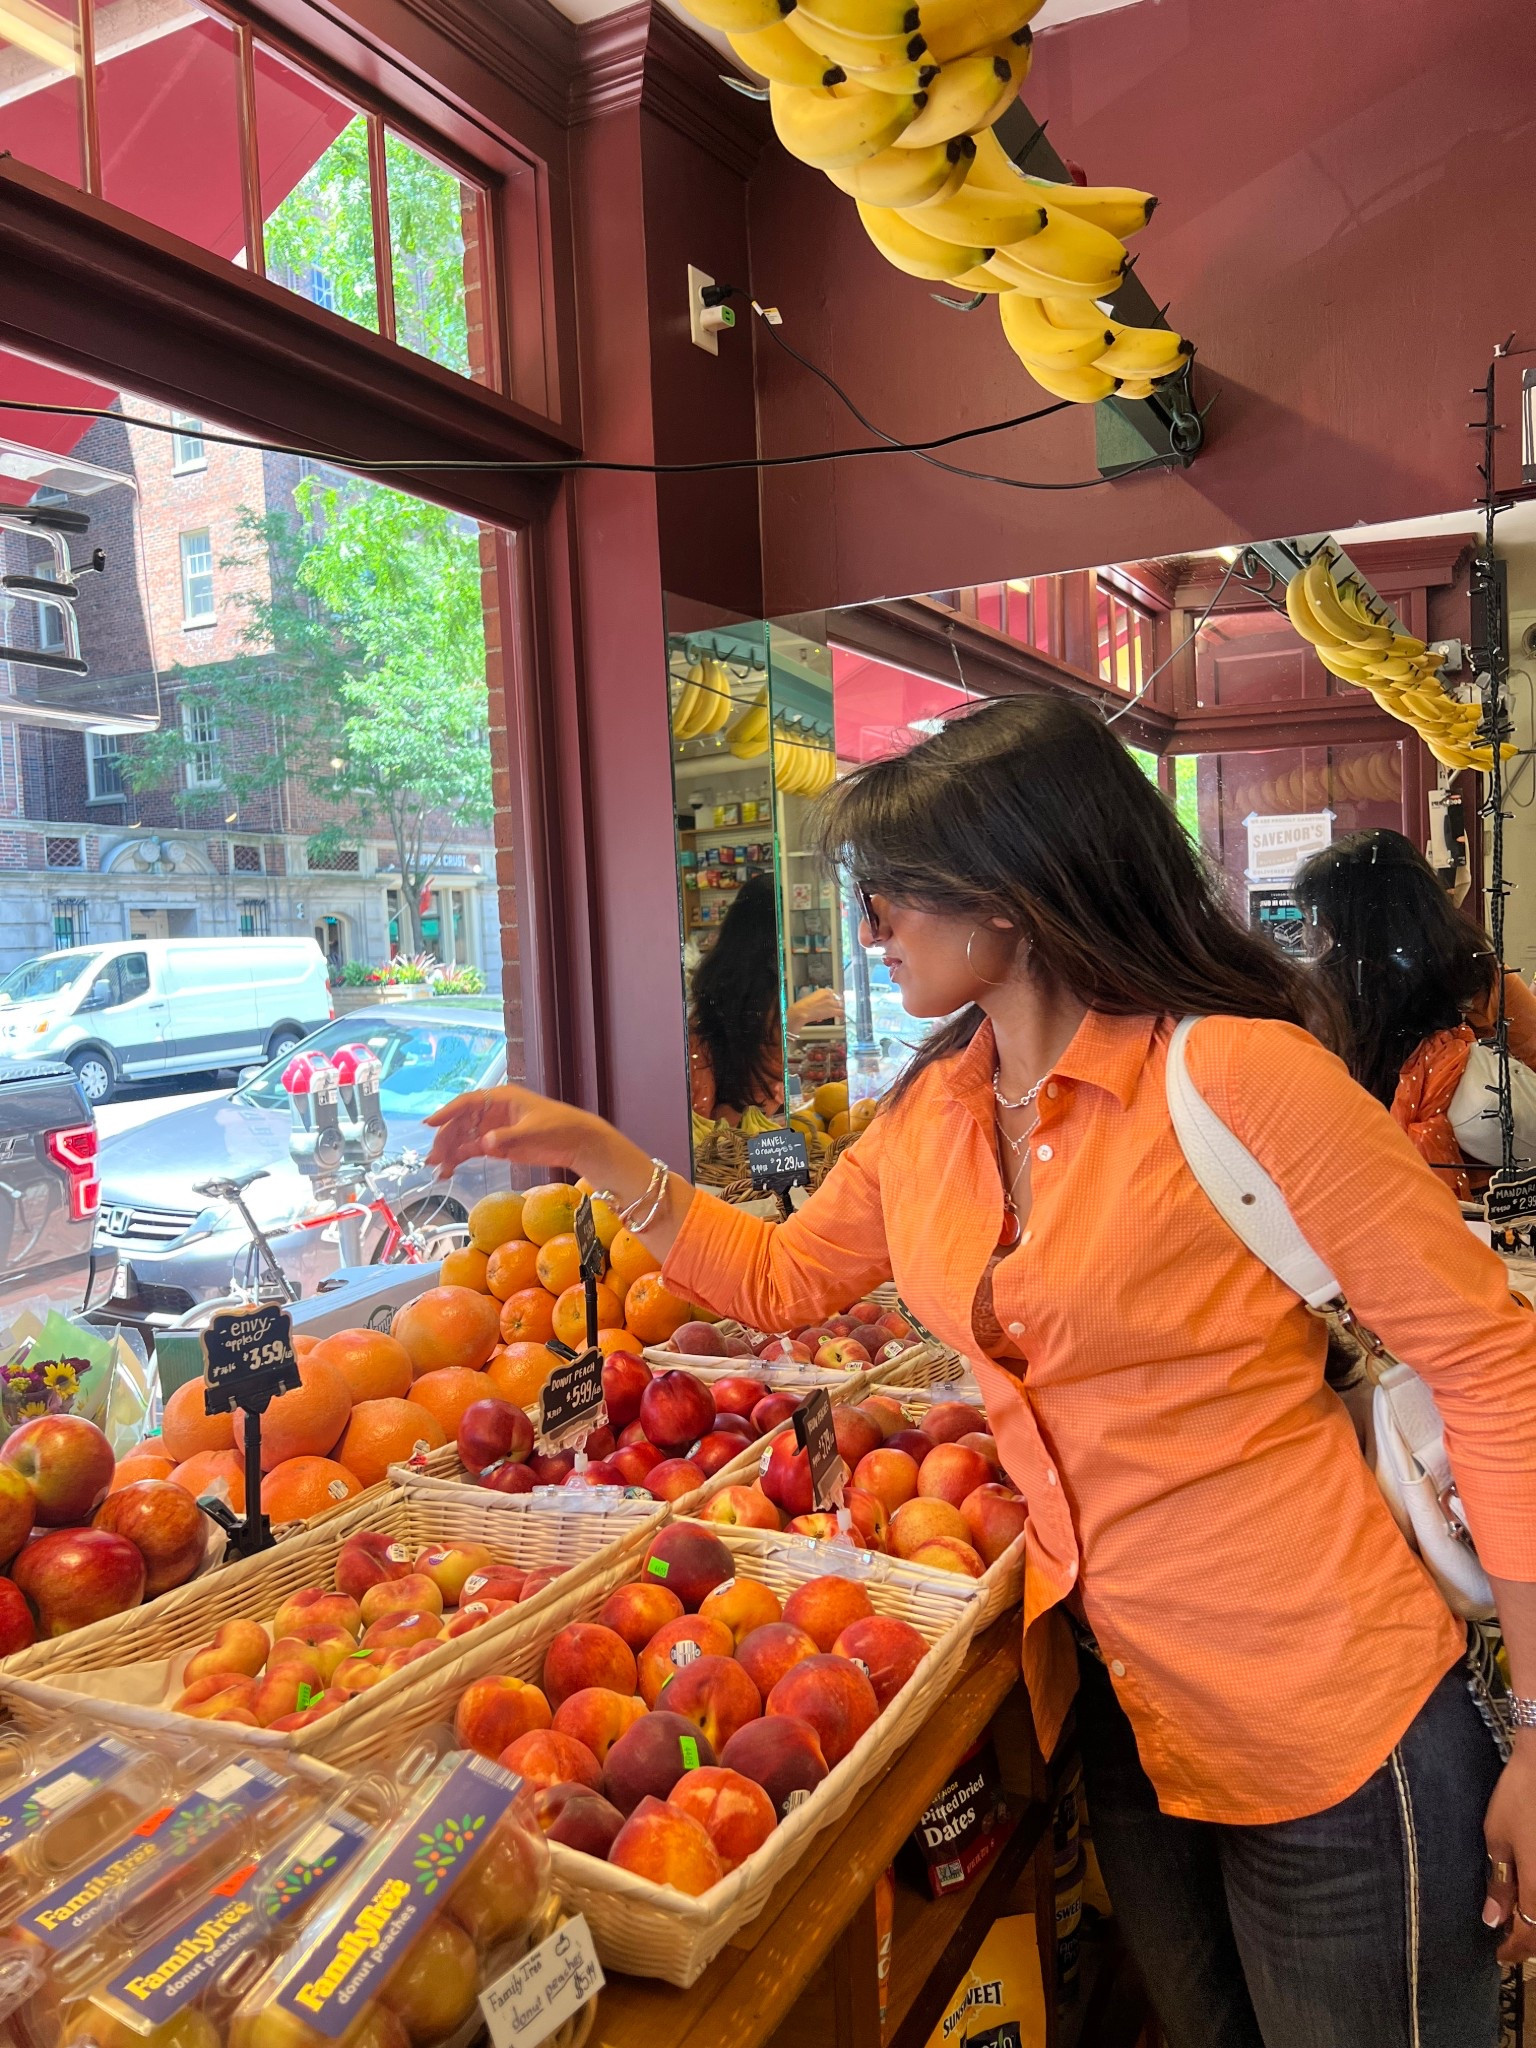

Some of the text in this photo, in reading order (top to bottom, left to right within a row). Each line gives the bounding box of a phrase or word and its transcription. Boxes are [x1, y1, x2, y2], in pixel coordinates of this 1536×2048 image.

[1252, 823, 1324, 849] SAVENOR'S
[443, 854, 467, 868] CRUST
[761, 1136, 785, 1147] NAVEL
[1496, 1184, 1536, 1199] MANDARI
[230, 1317, 272, 1341] envy
[551, 1362, 595, 1391] DONUT PEACH
[920, 1773, 985, 1826] Pitted Dried
[923, 1806, 976, 1848] Dates
[165, 1921, 256, 1997] donut peaches
[338, 1905, 417, 2005] donut peaches
[487, 1961, 543, 2013] Family Tree
[511, 1952, 585, 2031] donut peaches
[942, 1980, 1005, 2040] SUNSWEET
